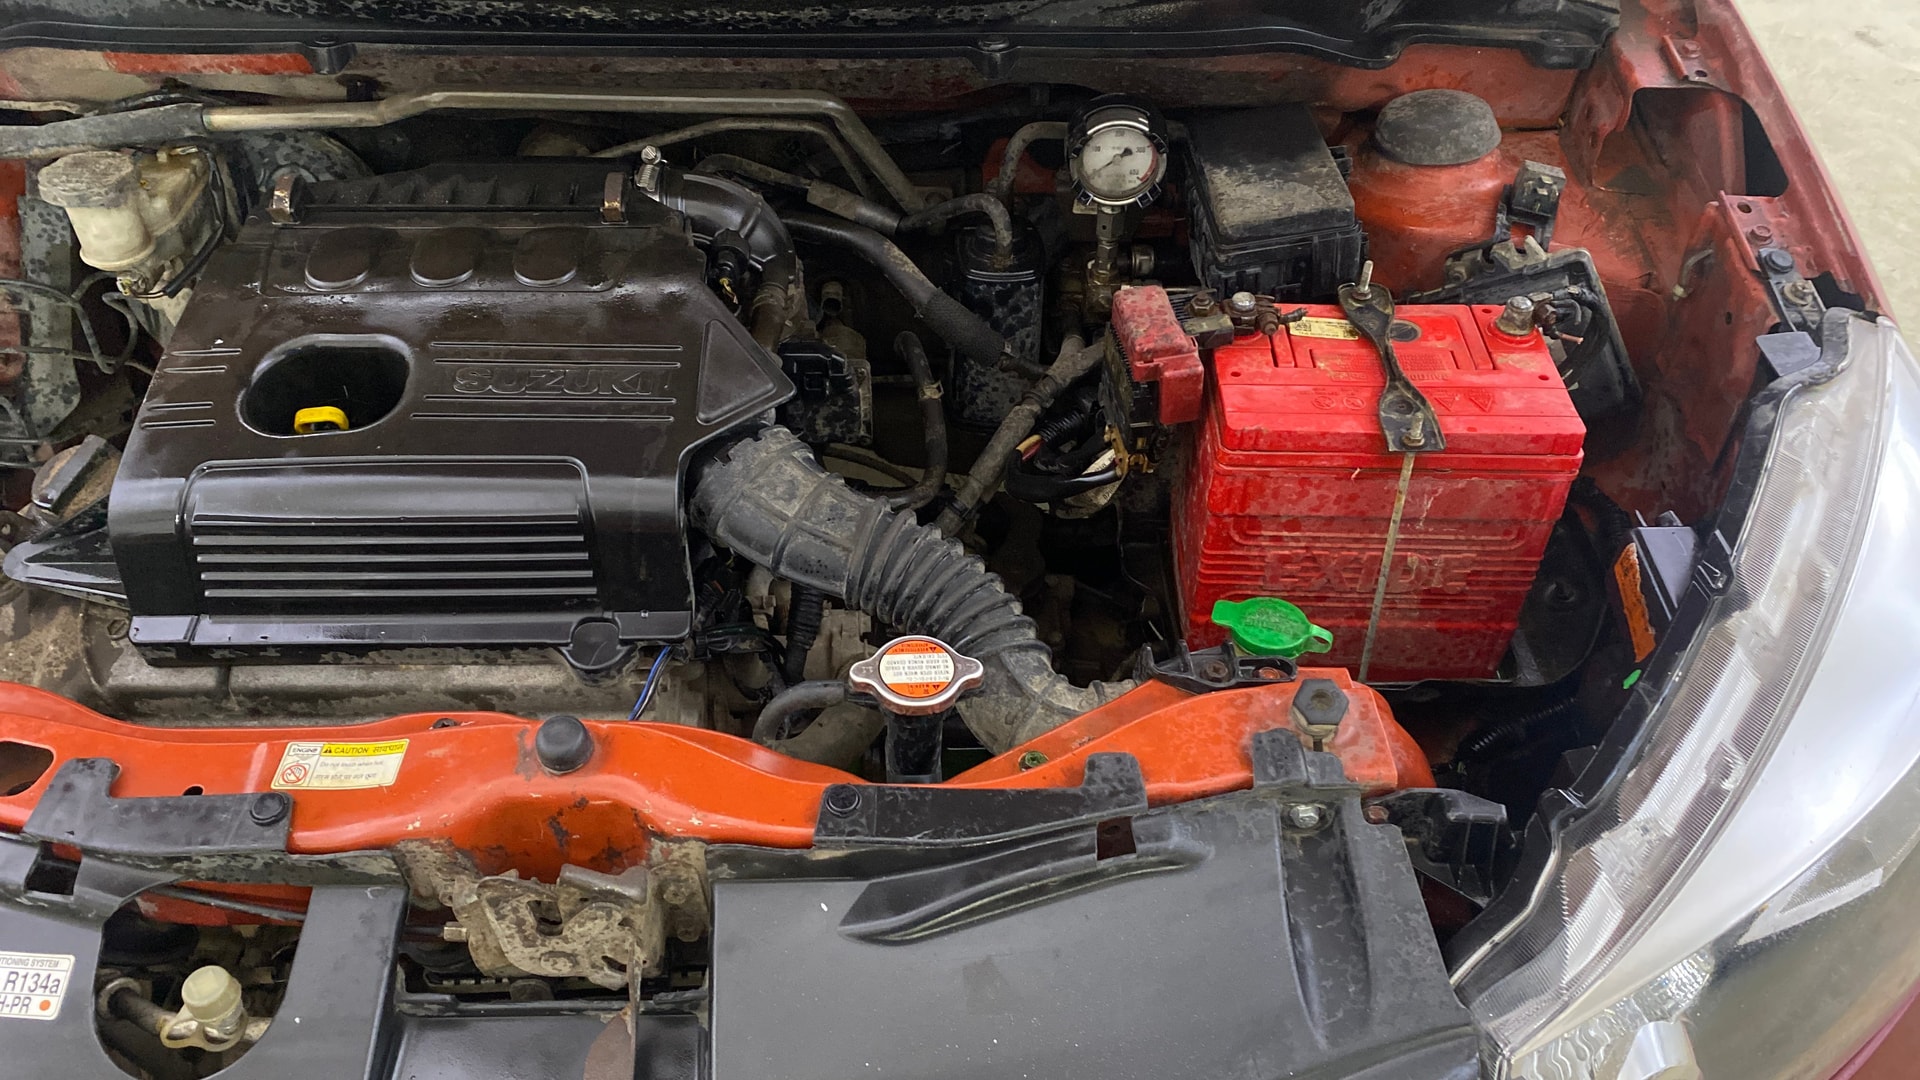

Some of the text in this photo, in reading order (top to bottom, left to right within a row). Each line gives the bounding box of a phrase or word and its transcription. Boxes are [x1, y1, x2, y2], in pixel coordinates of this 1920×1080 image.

[453, 366, 654, 396] SUZUKI
[1261, 551, 1477, 594] EXIDE
[334, 746, 369, 754] CAUTION
[0, 956, 59, 968] TIONING SYSTEM
[3, 970, 61, 994] R134a
